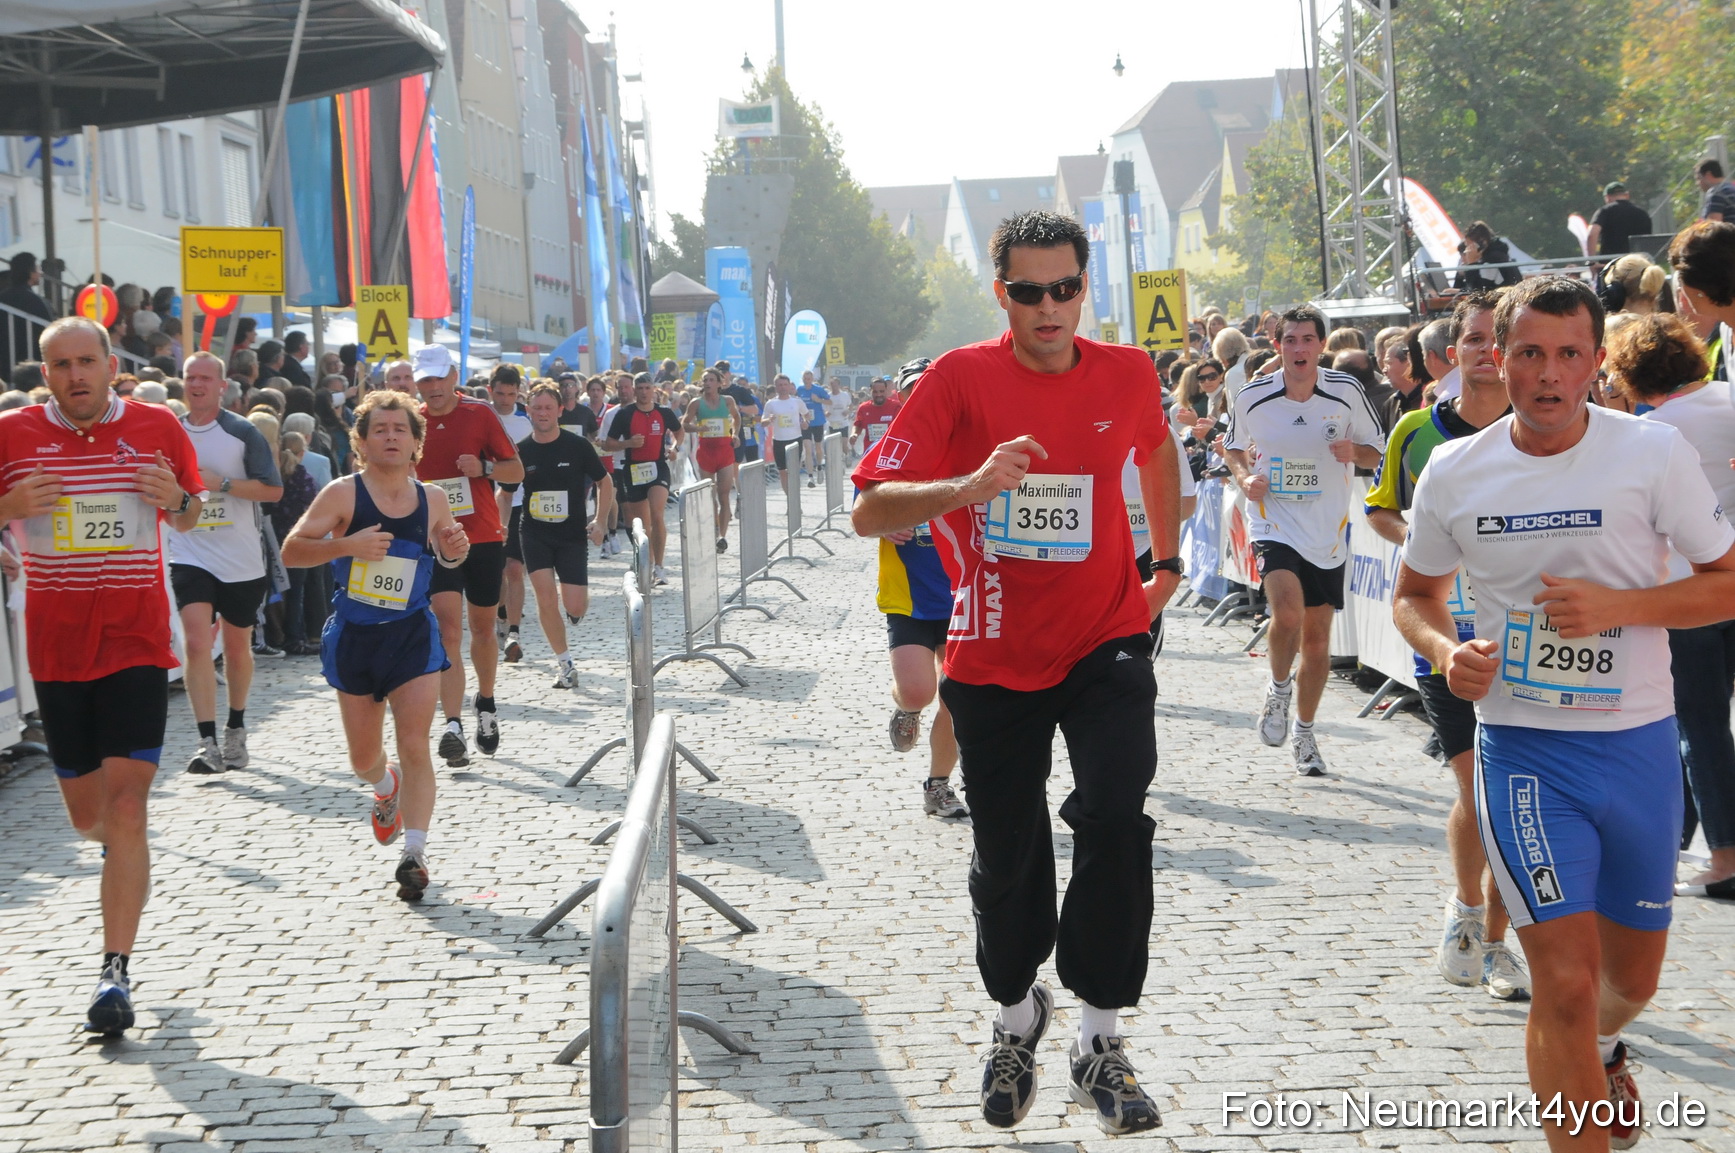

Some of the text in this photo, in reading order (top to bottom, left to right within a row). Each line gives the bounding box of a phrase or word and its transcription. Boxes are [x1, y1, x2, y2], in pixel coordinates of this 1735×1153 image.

[188, 245, 278, 262] Schnupper-
[219, 265, 248, 278] lauf
[1138, 273, 1180, 290] Block
[361, 288, 402, 303] Block
[1147, 294, 1177, 333] A
[368, 308, 398, 346] A
[1105, 330, 1116, 343] B
[831, 346, 840, 360] B
[1285, 461, 1316, 470] Christian
[641, 470, 654, 478] 171
[1286, 474, 1319, 486] 2738
[1017, 482, 1082, 499] Maximilian
[75, 501, 117, 514] Thomas
[543, 503, 562, 513] 615
[1016, 507, 1080, 531] 3563
[1511, 511, 1598, 531] BÜSCHEL
[84, 521, 125, 540] 225
[1551, 530, 1603, 539] WERKZEUGBAU
[1050, 547, 1090, 556] PFLEIDERER
[373, 574, 404, 592] 980
[983, 570, 1003, 639] MAX
[1512, 636, 1519, 650] C
[1537, 643, 1614, 674] 2998
[1574, 693, 1621, 703] PFLEIDERER
[1516, 782, 1545, 865] BÜSCHEL
